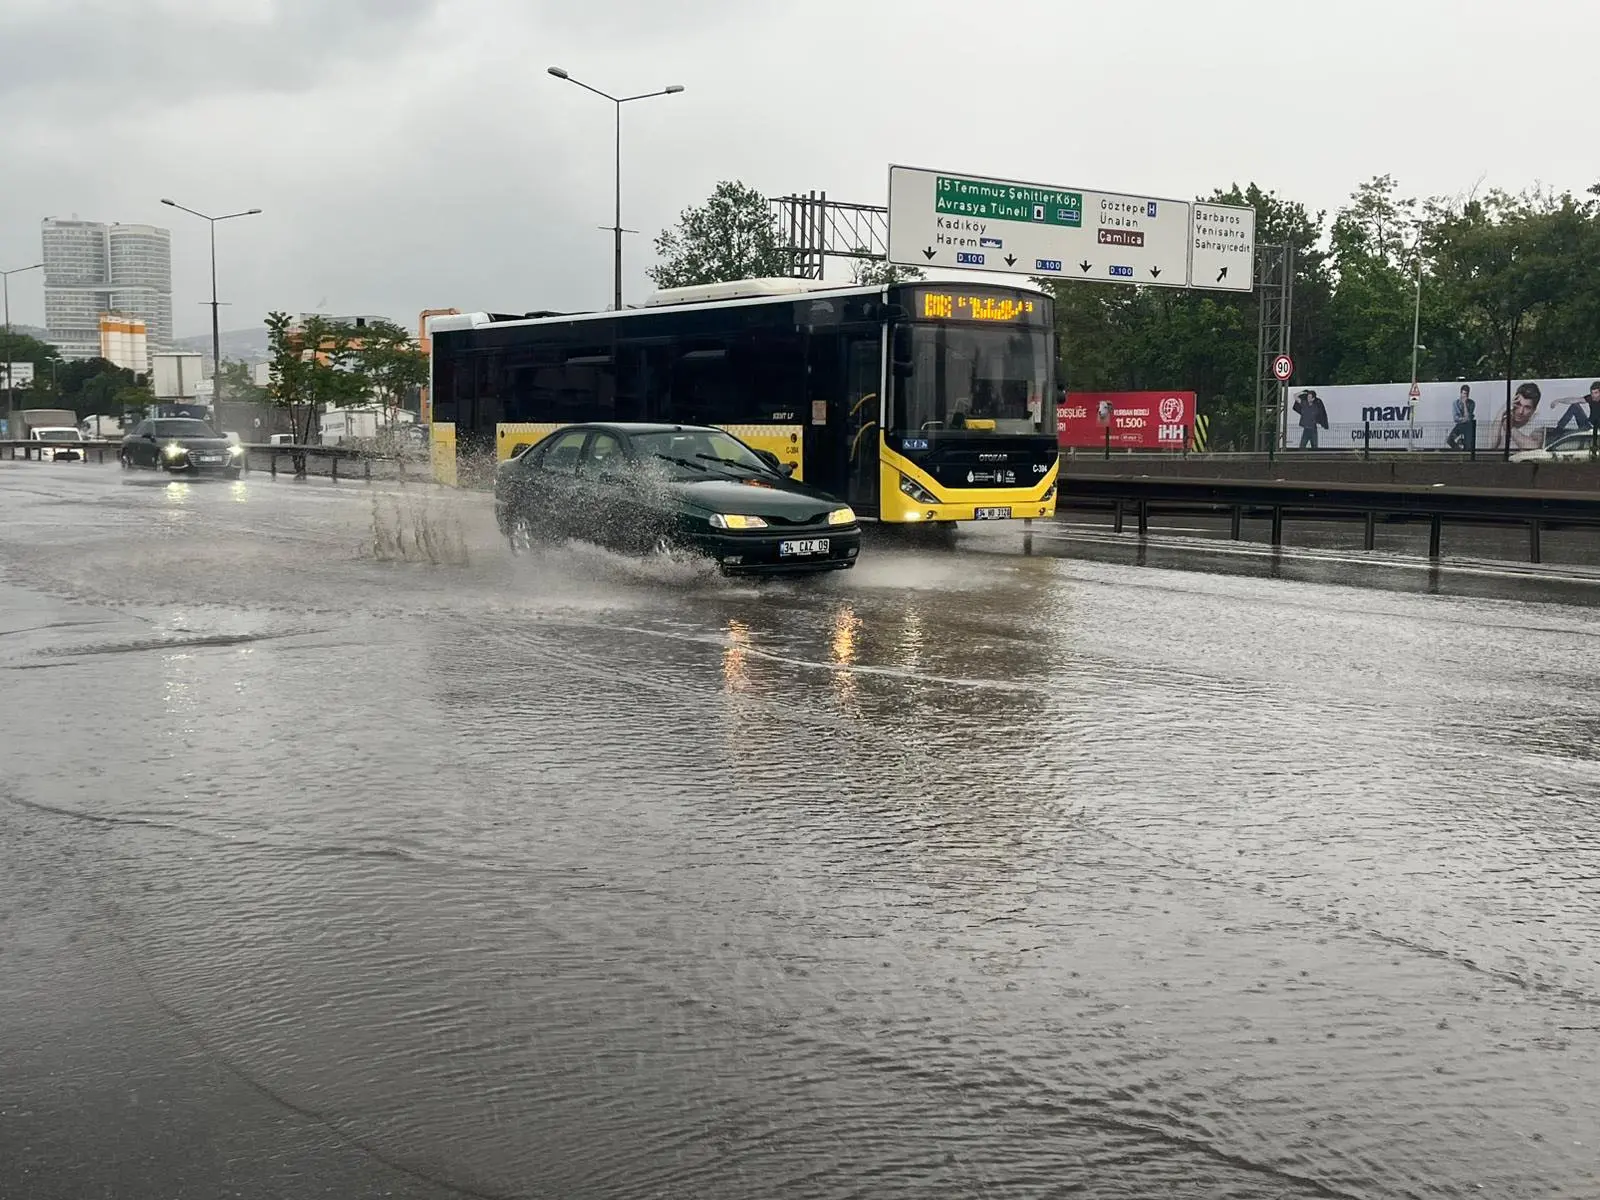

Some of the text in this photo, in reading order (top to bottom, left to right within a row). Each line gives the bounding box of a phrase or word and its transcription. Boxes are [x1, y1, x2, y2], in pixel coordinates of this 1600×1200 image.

[937, 179, 1080, 207] 15 Temmuz Şehitler Köp.
[937, 197, 1028, 217] Avrasya Tüneli
[1100, 213, 1138, 228] Ünalan
[1195, 210, 1240, 225] Barbaros
[936, 217, 987, 234] Kadıköy
[936, 233, 977, 247] Harem
[1195, 238, 1250, 253] Sahrayıcedit
[1277, 361, 1289, 373] 90
[1362, 401, 1412, 421] mavi
[1369, 429, 1382, 439] MU
[1383, 429, 1401, 441] ÇOK
[784, 540, 828, 553] 34 CAZ 09
